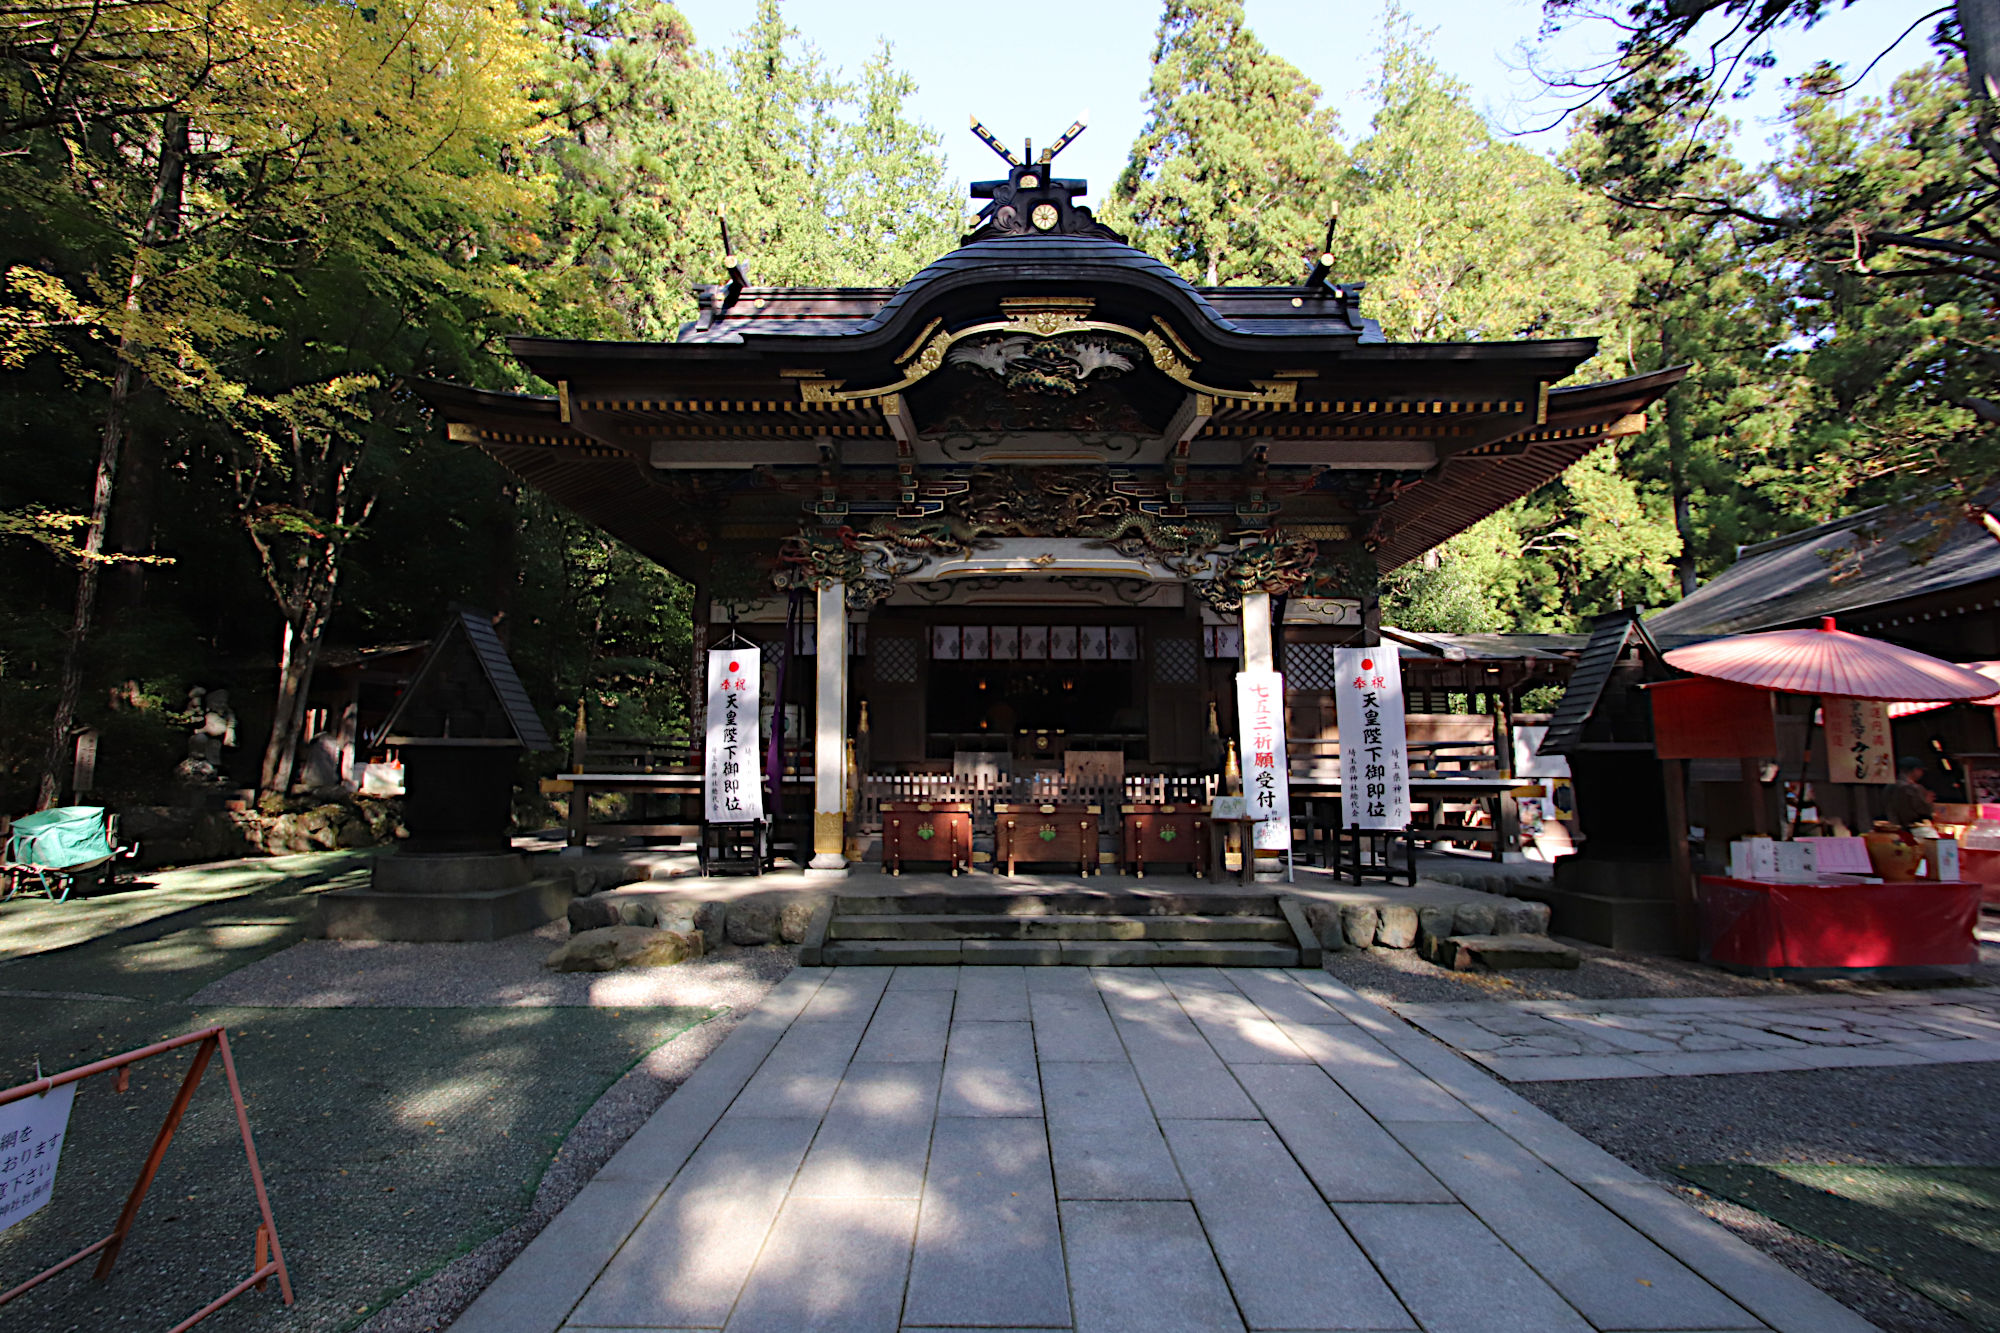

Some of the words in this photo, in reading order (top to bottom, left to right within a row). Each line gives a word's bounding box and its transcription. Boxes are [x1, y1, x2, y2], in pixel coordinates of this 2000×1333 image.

[720, 678, 746, 691] 奉祝
[1353, 676, 1387, 689] 奉祝
[723, 693, 743, 811] 天皇陛下御即位
[1249, 683, 1276, 808] 七五三祈願受付
[1361, 691, 1387, 818] 天皇陛下御即位
[1391, 748, 1403, 817] 埼玉県神社庁
